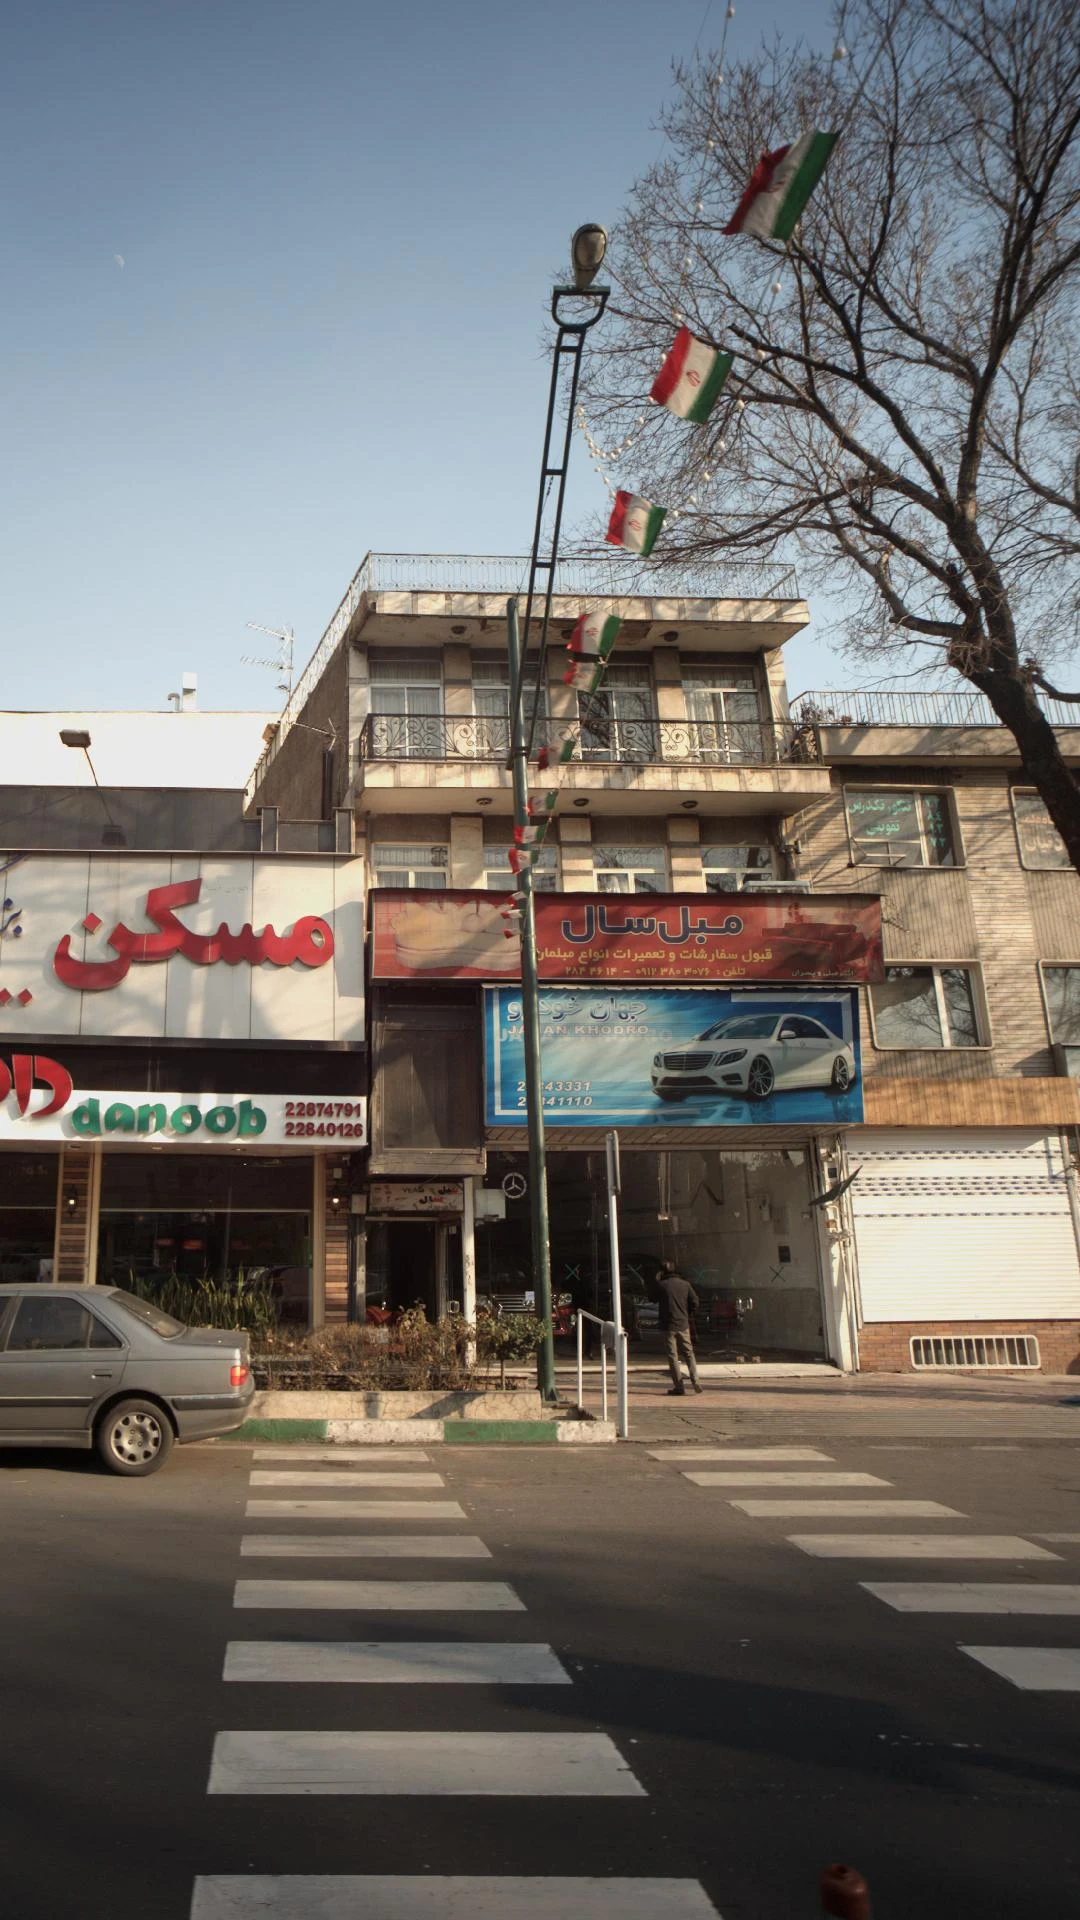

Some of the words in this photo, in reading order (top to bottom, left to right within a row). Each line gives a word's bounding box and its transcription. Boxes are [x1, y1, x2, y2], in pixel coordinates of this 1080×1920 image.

[561, 904, 657, 944] سال
[657, 905, 744, 945] مبل
[53, 877, 335, 991] مسکن
[578, 948, 609, 964] انواع
[612, 948, 666, 962] تعمیرات
[669, 951, 676, 962] و
[680, 948, 738, 963] سفارشات
[742, 948, 773, 963] قبول
[722, 966, 746, 977] تلفن
[507, 997, 583, 1022] خودو
[590, 998, 648, 1022] جهان
[72, 1098, 267, 1137] danoob
[285, 1102, 361, 1118] 22874791
[285, 1122, 363, 1137] 22840126
